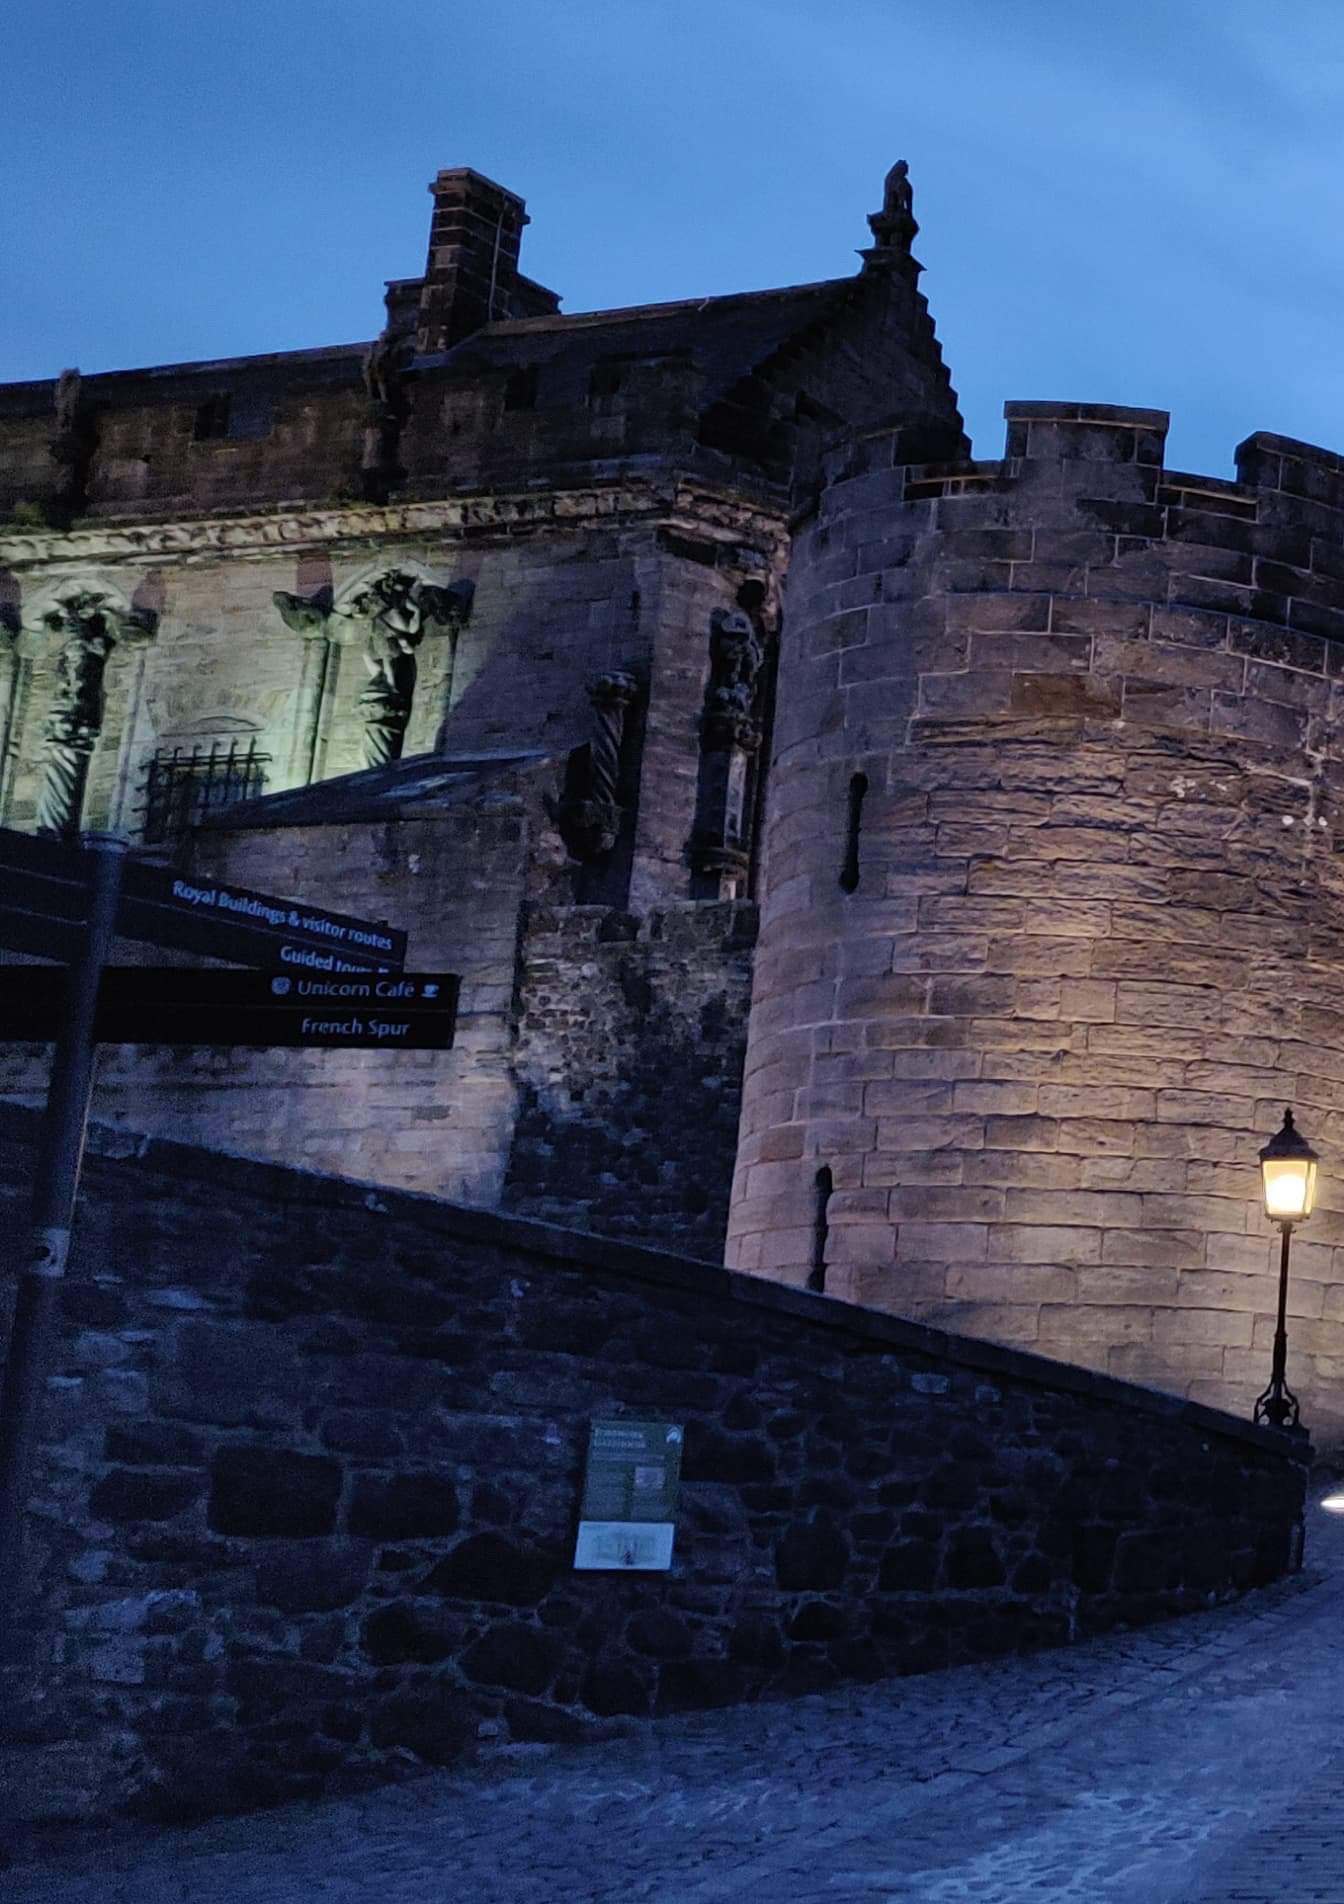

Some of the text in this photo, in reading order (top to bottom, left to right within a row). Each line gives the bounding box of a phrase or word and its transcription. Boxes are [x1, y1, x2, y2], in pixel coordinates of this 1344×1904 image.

[172, 880, 393, 950] Royal Buildings & visitor routes
[280, 945, 335, 971] Guided
[297, 979, 416, 998] Unicorn Café
[301, 1017, 411, 1040] French Spur
